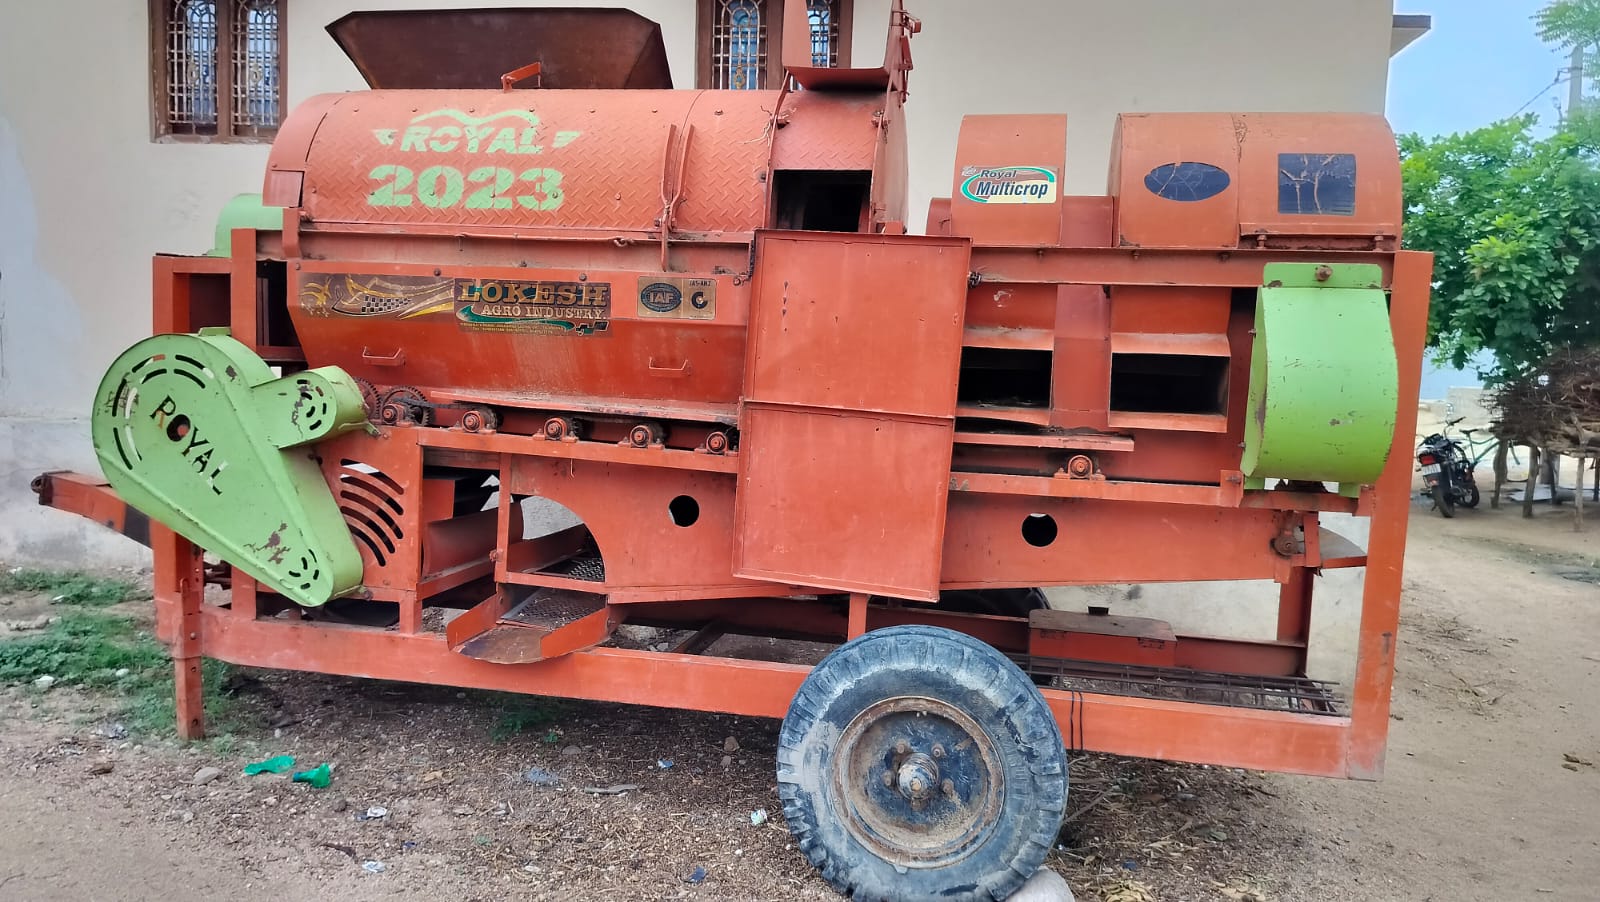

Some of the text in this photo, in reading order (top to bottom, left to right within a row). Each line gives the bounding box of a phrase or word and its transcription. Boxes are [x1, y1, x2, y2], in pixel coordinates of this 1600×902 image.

[400, 126, 544, 154] ROYAL
[980, 170, 1017, 180] Royal
[367, 164, 565, 210] 2023
[975, 181, 1048, 199] Multicrop
[458, 282, 607, 306] LOKESH
[648, 291, 675, 304] IAF
[480, 304, 521, 317] AGRO
[149, 394, 228, 495] ROYAL
